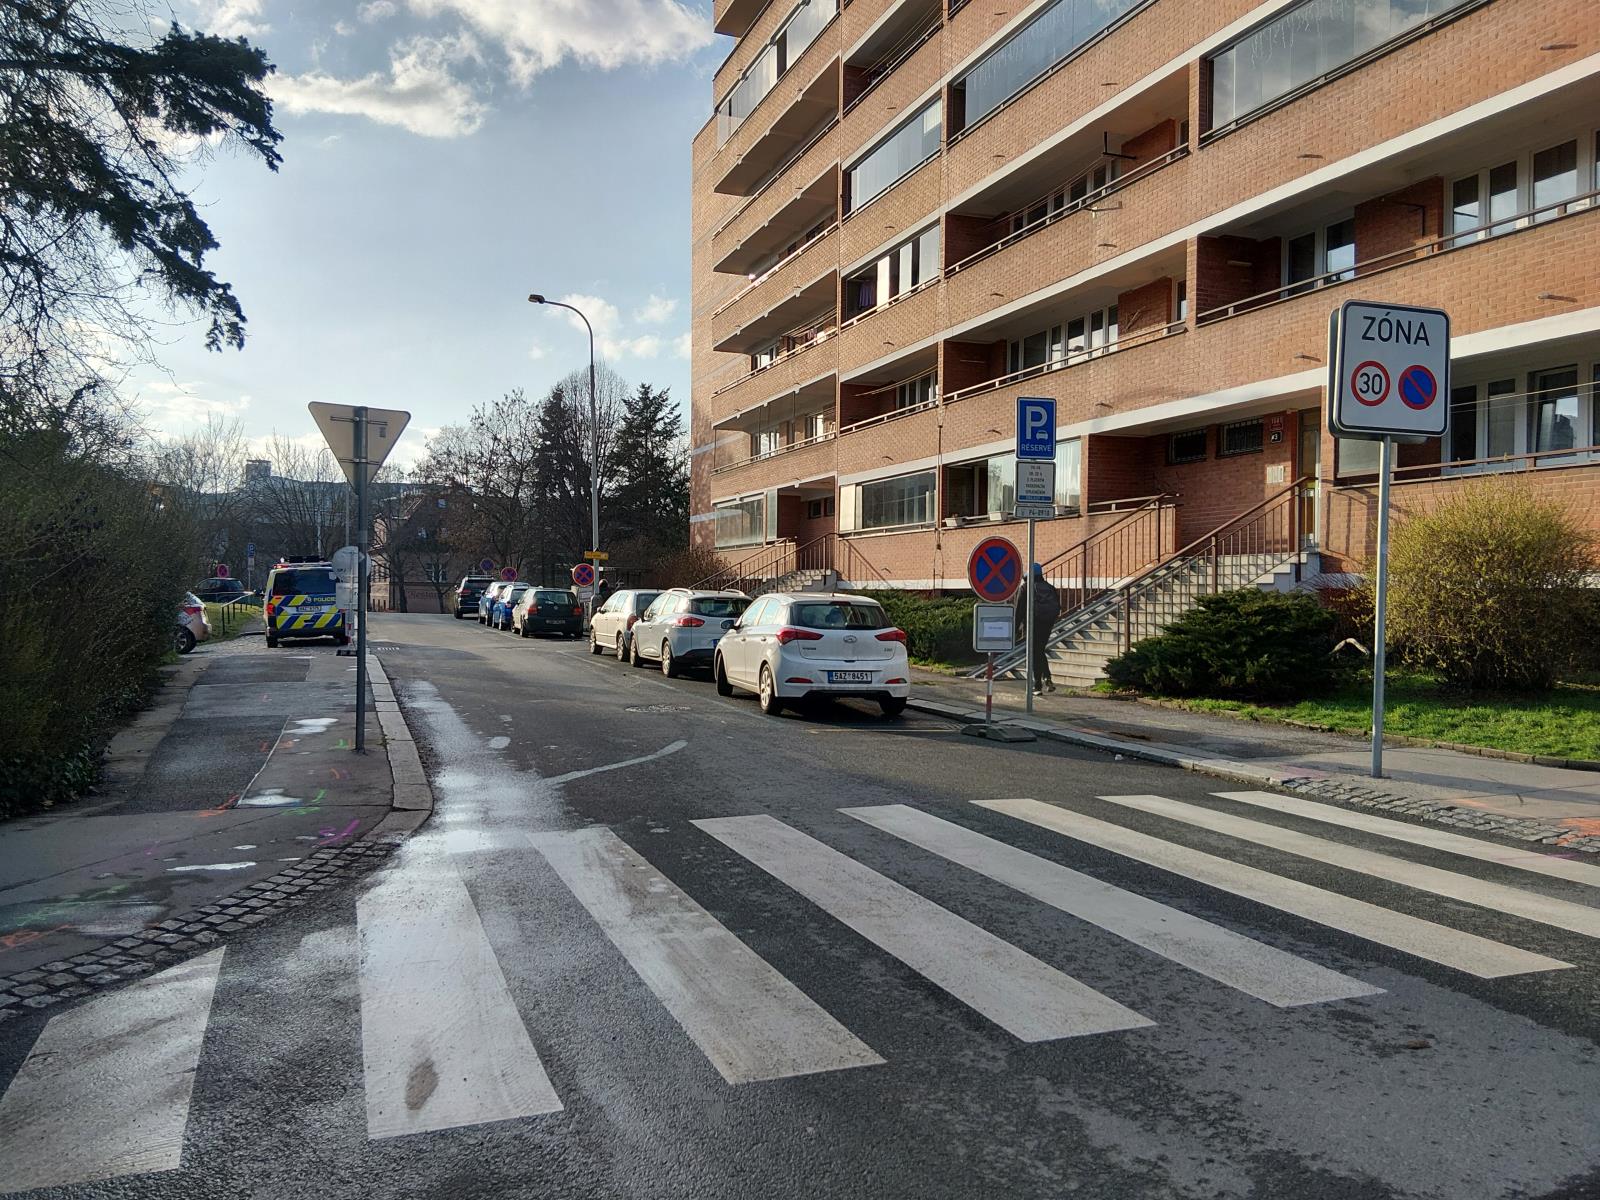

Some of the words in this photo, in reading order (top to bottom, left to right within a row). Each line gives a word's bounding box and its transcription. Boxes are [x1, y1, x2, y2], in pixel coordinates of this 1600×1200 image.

[1362, 311, 1430, 346] ZÓNA
[1359, 372, 1382, 395] 30
[1025, 405, 1048, 440] P
